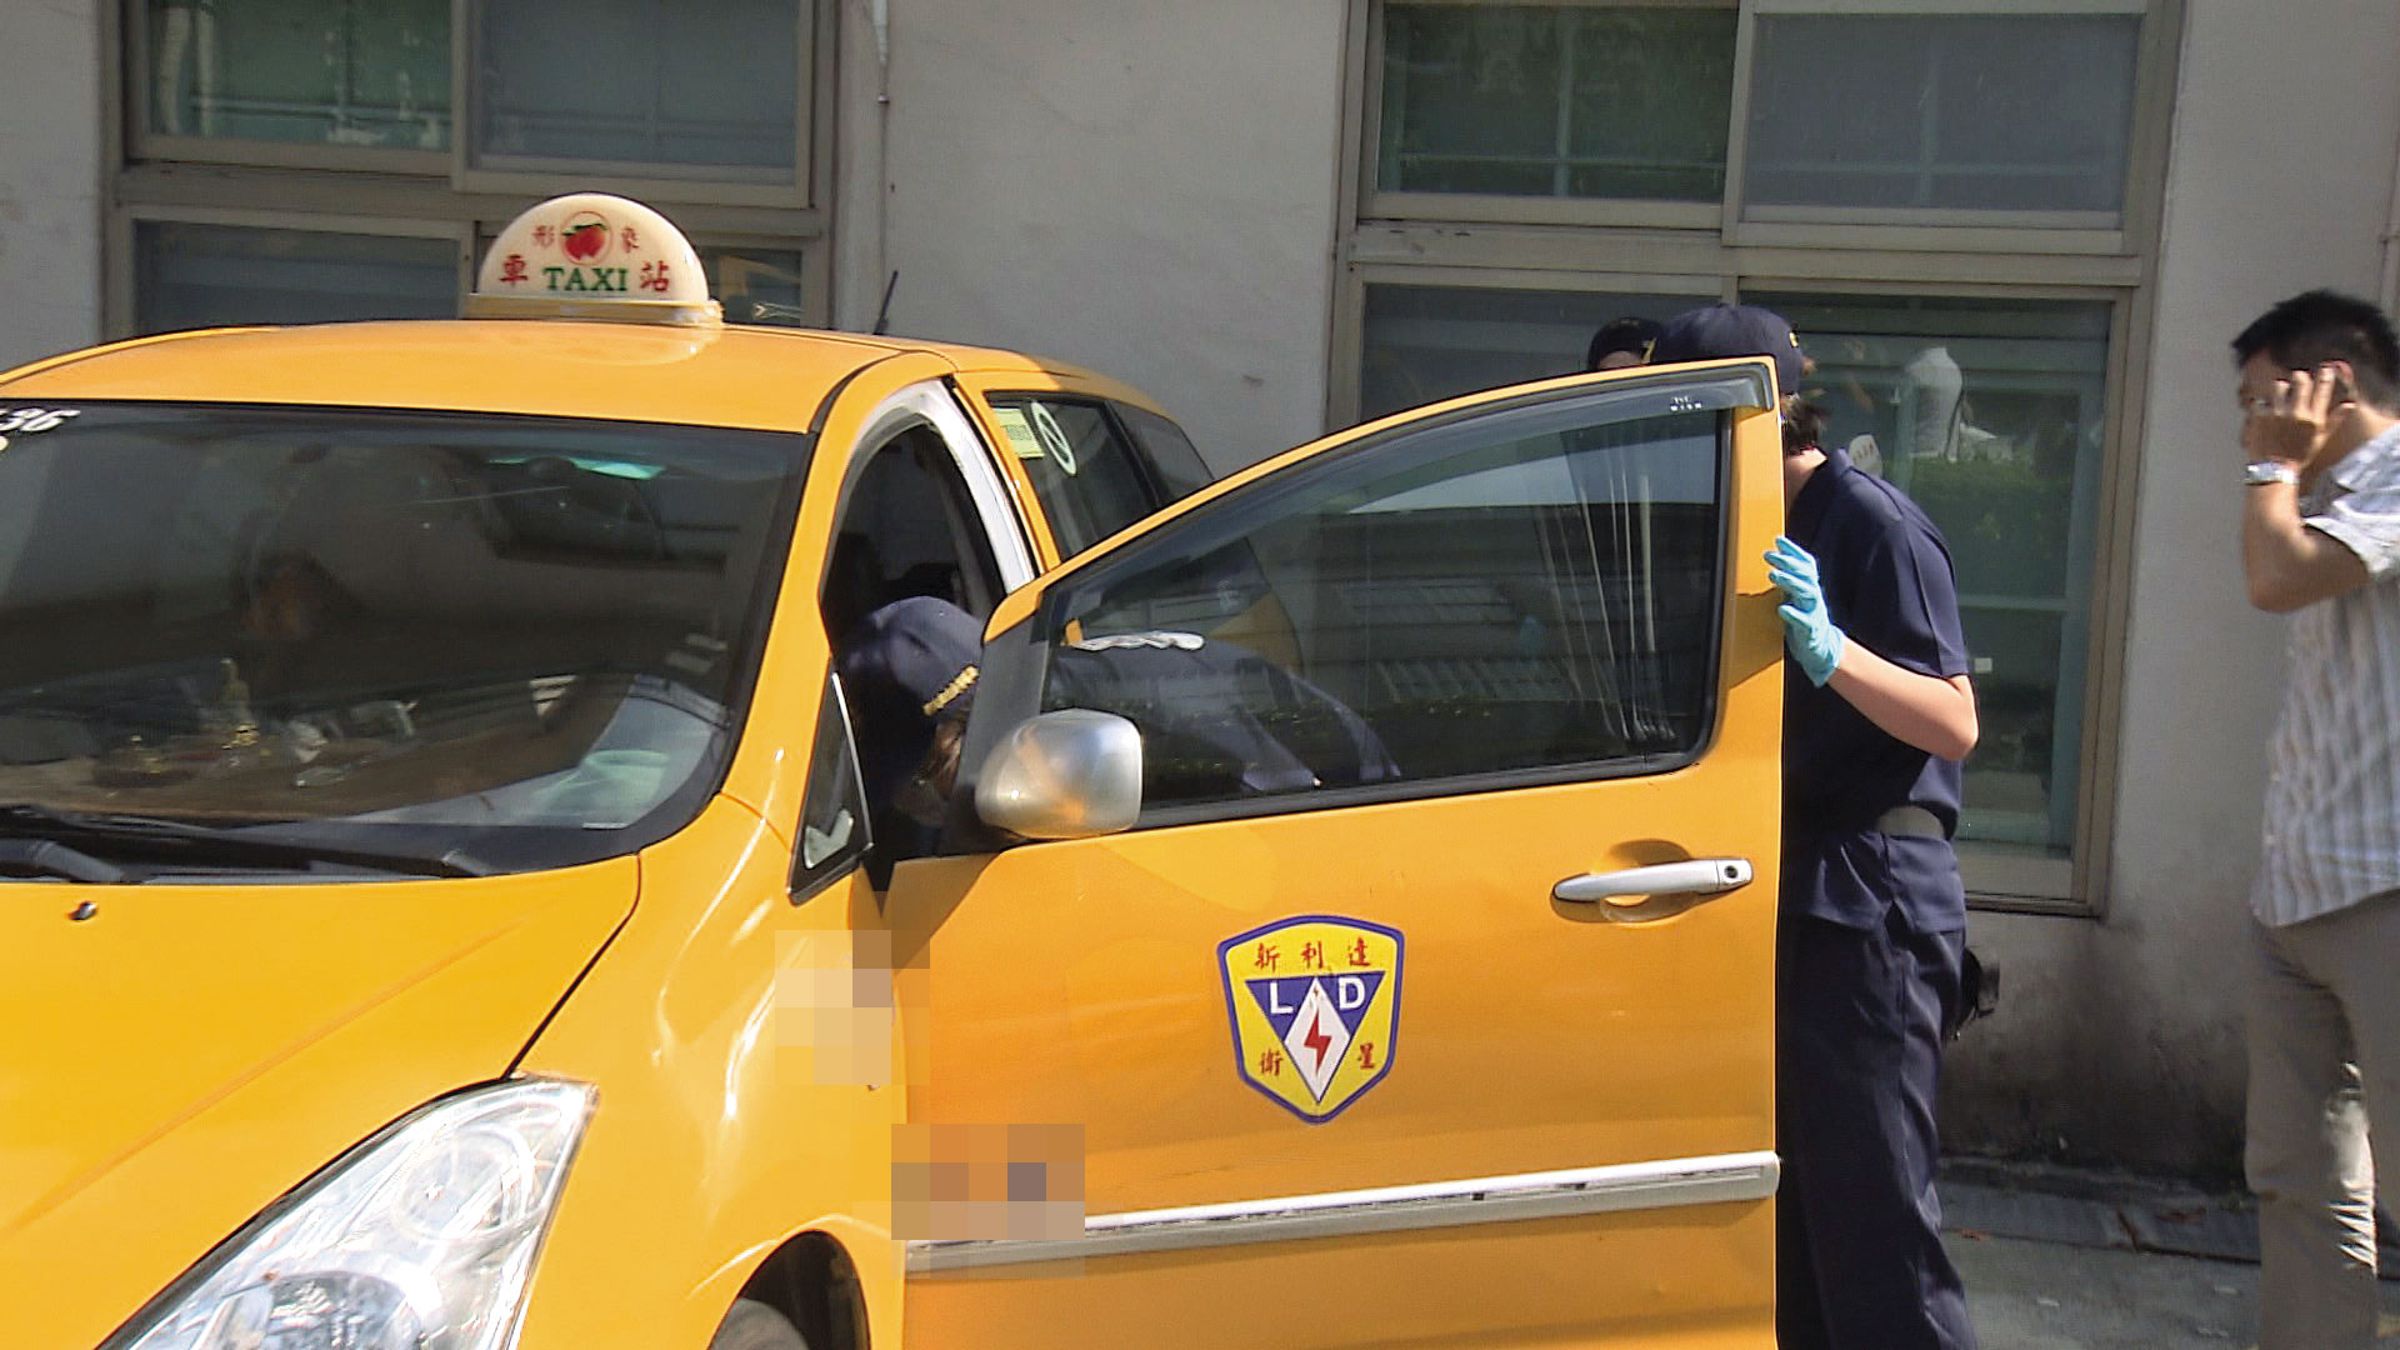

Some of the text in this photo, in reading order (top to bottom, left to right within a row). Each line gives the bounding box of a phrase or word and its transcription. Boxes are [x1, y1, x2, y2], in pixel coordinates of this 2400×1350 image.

[499, 254, 670, 293] 車 TAXI 站
[0, 407, 81, 432] 36
[1254, 936, 1371, 973] 新利達
[1268, 976, 1366, 1015] L D
[1356, 1042, 1376, 1070] 星
